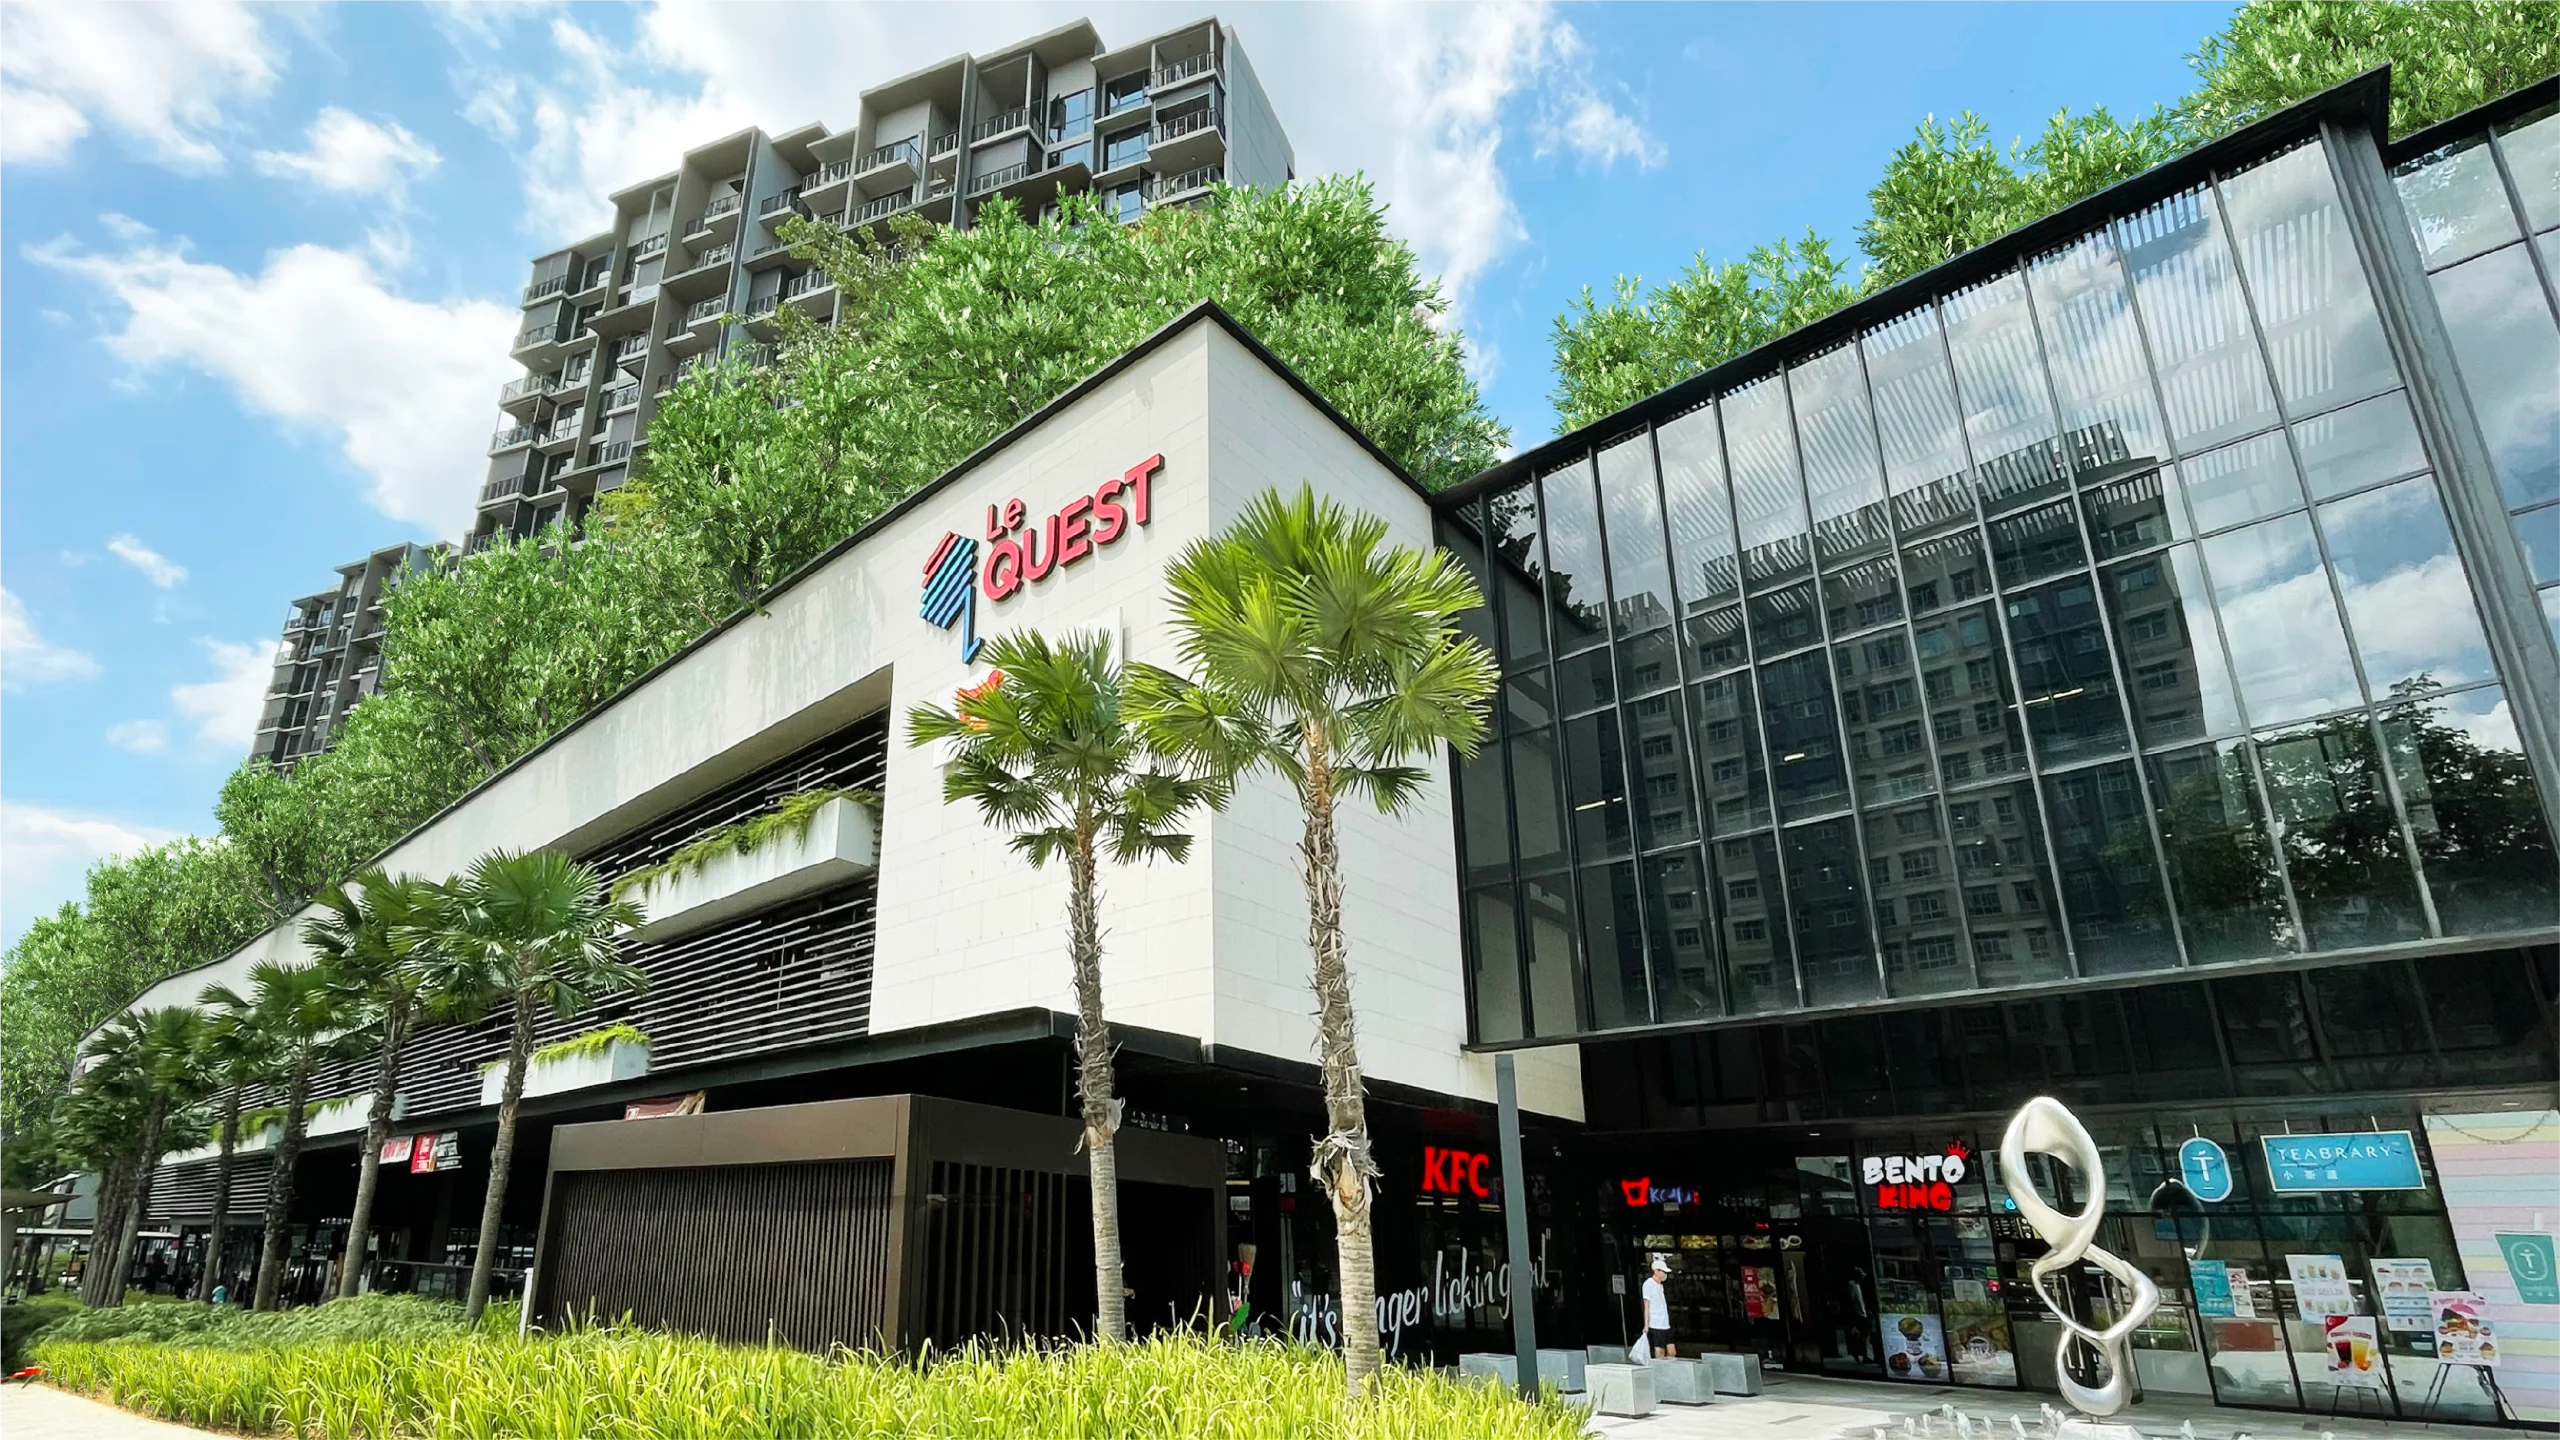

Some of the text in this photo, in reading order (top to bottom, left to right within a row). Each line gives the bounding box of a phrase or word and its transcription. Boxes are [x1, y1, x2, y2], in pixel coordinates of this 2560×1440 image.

[983, 453, 1165, 602] QUEST
[987, 497, 1026, 541] Le
[1422, 1146, 1490, 1197] KFC
[1862, 1154, 1966, 1185] BENTO
[2277, 1145, 2392, 1161] TEABRARY
[1877, 1181, 1953, 1211] KING
[1375, 1286, 1429, 1357] nger
